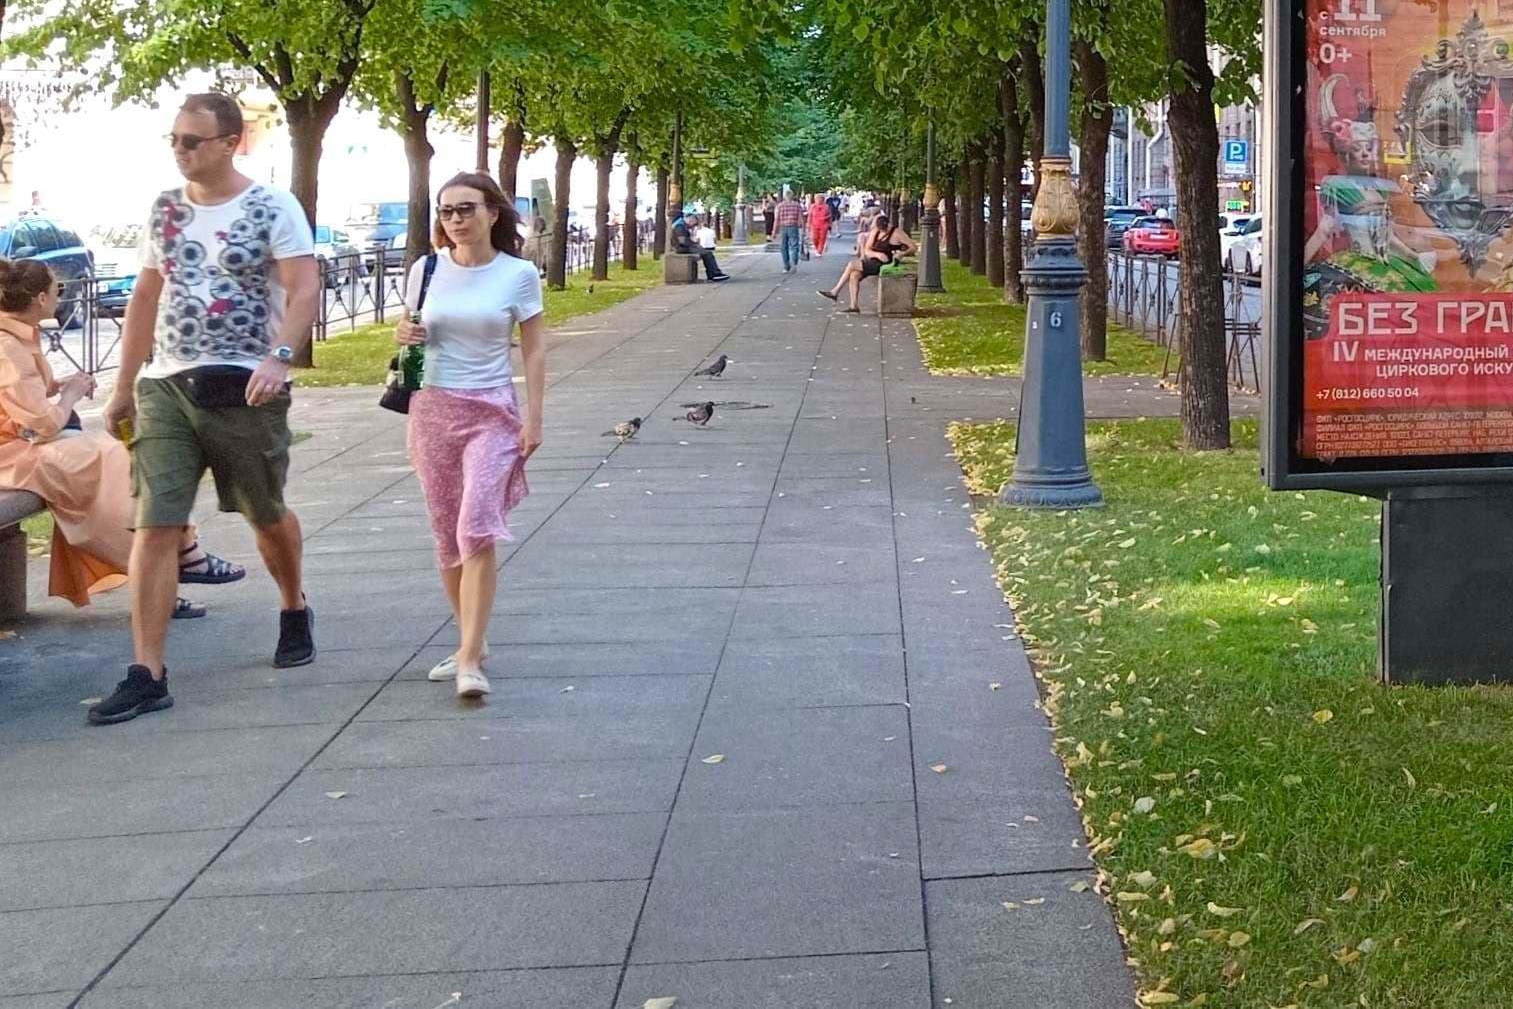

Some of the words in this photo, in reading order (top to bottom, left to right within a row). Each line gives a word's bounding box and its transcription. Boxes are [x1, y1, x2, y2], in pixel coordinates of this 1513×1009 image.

[1320, 25, 1386, 39] сентября
[1320, 43, 1352, 64] 0+
[1050, 312, 1062, 327] 6
[1338, 302, 1418, 335] БЕЗ
[1333, 341, 1359, 362] IV
[1364, 345, 1508, 362] МЕЖДУНАРОДНЫЙ
[1376, 363, 1469, 379] ЦИРКОВОГО
[1316, 389, 1330, 400] +7
[1331, 388, 1360, 401] (812)
[1362, 388, 1385, 399] 660
[1387, 388, 1402, 398] 50
[1404, 387, 1419, 397] 04
